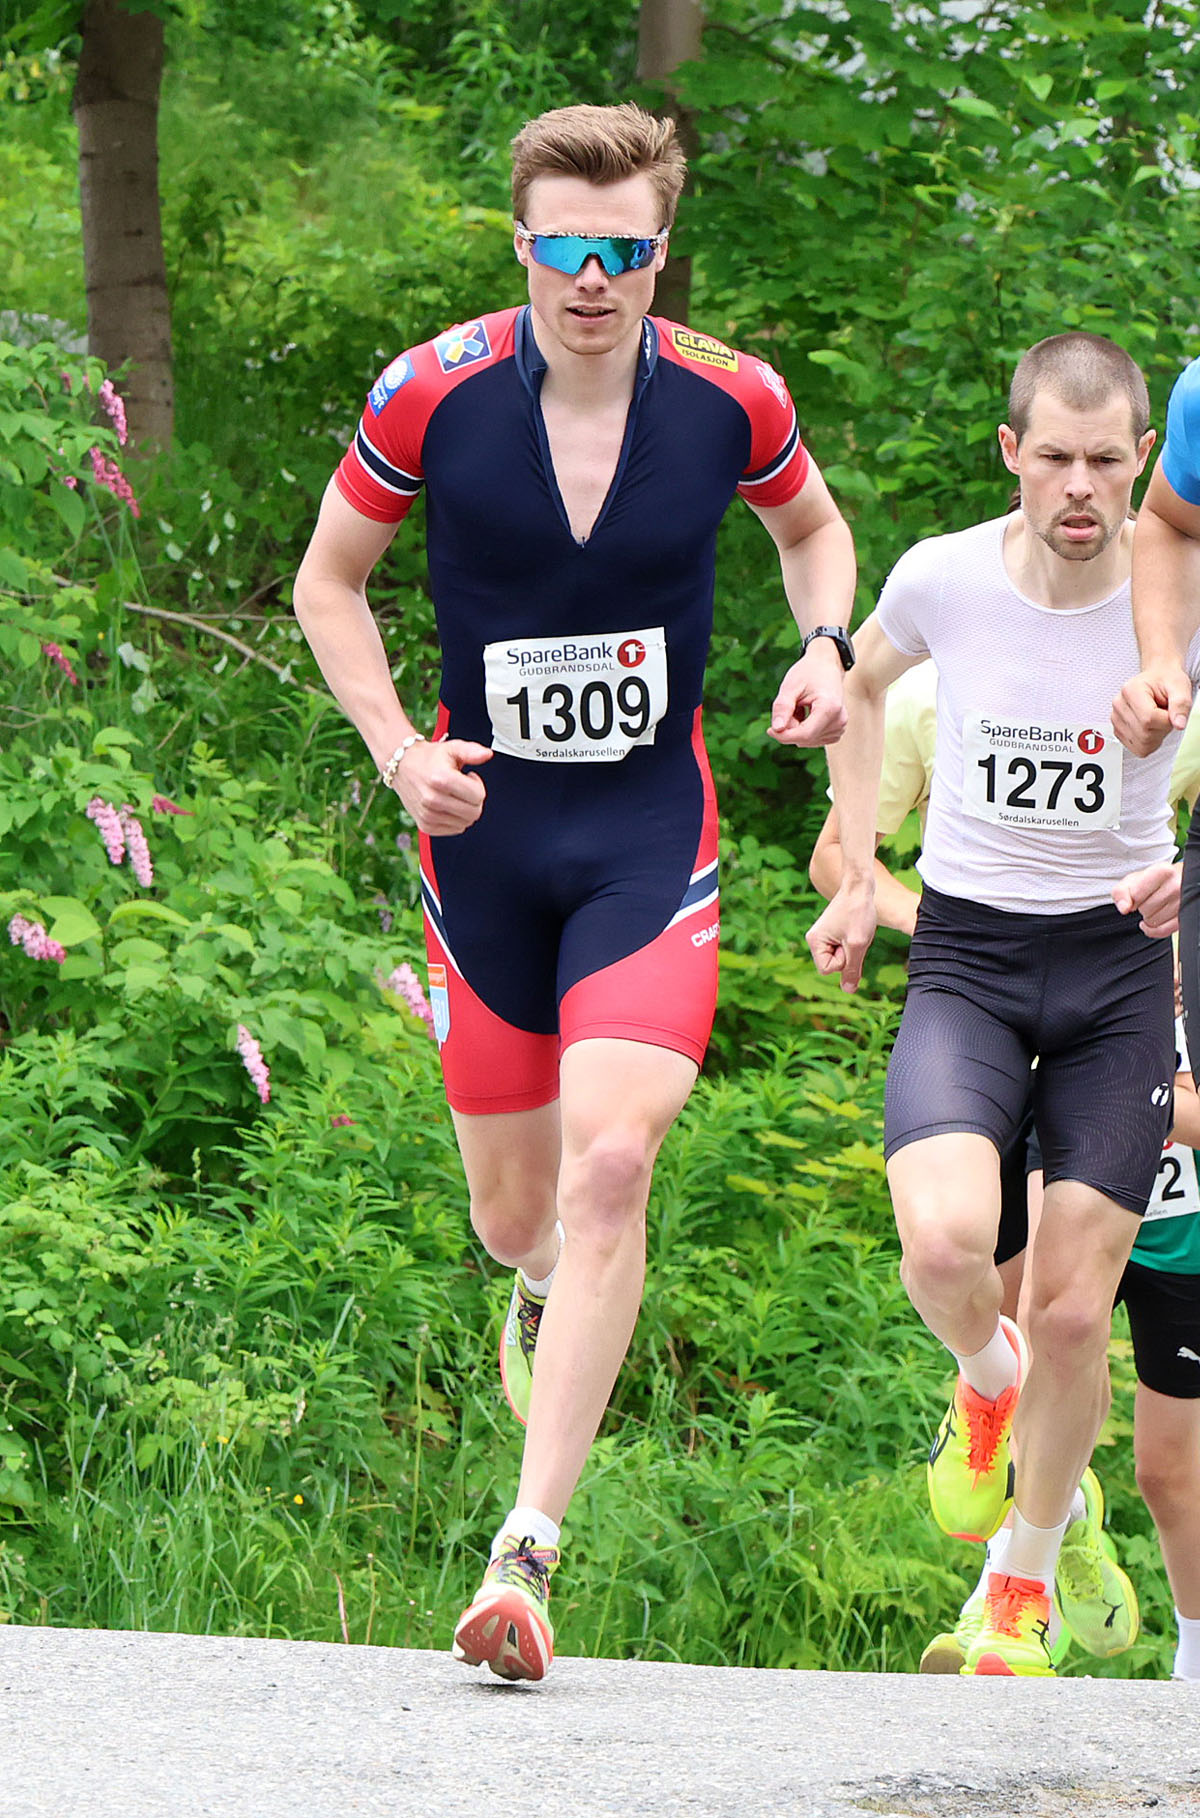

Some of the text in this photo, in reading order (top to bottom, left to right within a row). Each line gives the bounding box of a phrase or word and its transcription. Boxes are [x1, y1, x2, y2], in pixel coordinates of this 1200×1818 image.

[676, 332, 734, 358] GLAVA
[682, 349, 729, 366] ISOLASJON
[507, 642, 613, 667] SpareBank
[519, 663, 615, 676] GUDBRANDSDAL
[507, 676, 650, 742] 1309
[980, 719, 1074, 743] SpareBank
[535, 747, 626, 758] Sørdalskarusellen
[989, 738, 1075, 753] GUDBRANDSDAL
[977, 753, 1105, 814] 1273
[998, 812, 1080, 827] Sørdalskarusellen
